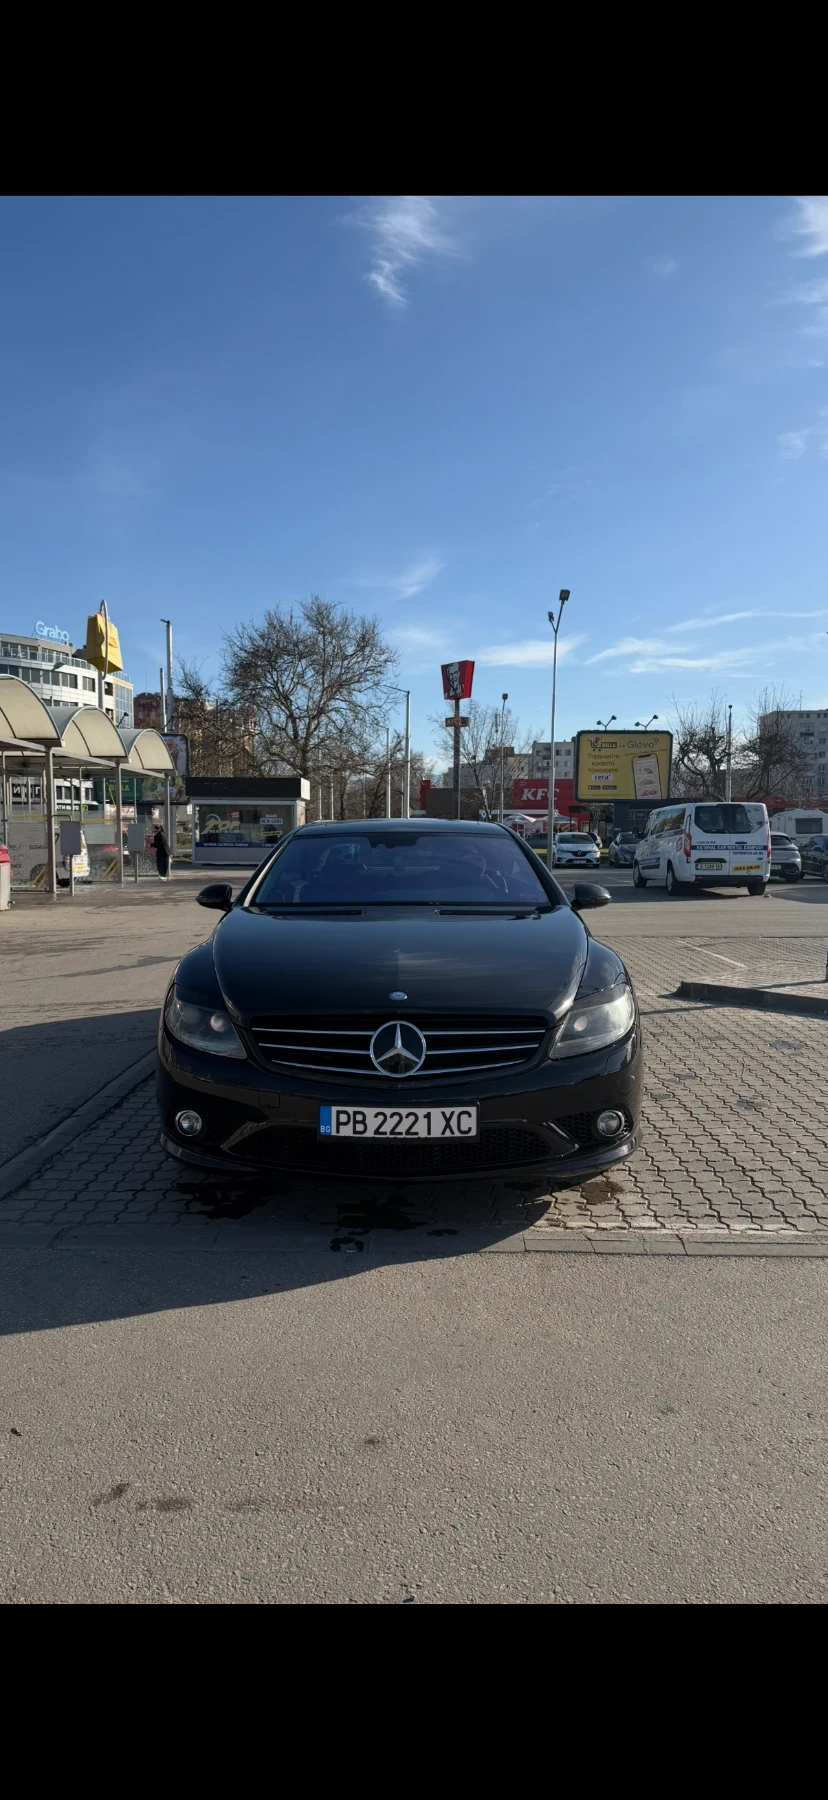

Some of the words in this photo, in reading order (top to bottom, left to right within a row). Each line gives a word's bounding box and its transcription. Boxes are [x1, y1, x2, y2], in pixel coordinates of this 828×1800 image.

[35, 621, 70, 641] Grabo
[627, 740, 656, 748] Glovo
[201, 820, 241, 834] TOP
[320, 1125, 331, 1133] BG
[335, 1110, 368, 1134] PB
[373, 1111, 432, 1136] 2221
[440, 1110, 472, 1135] XC
